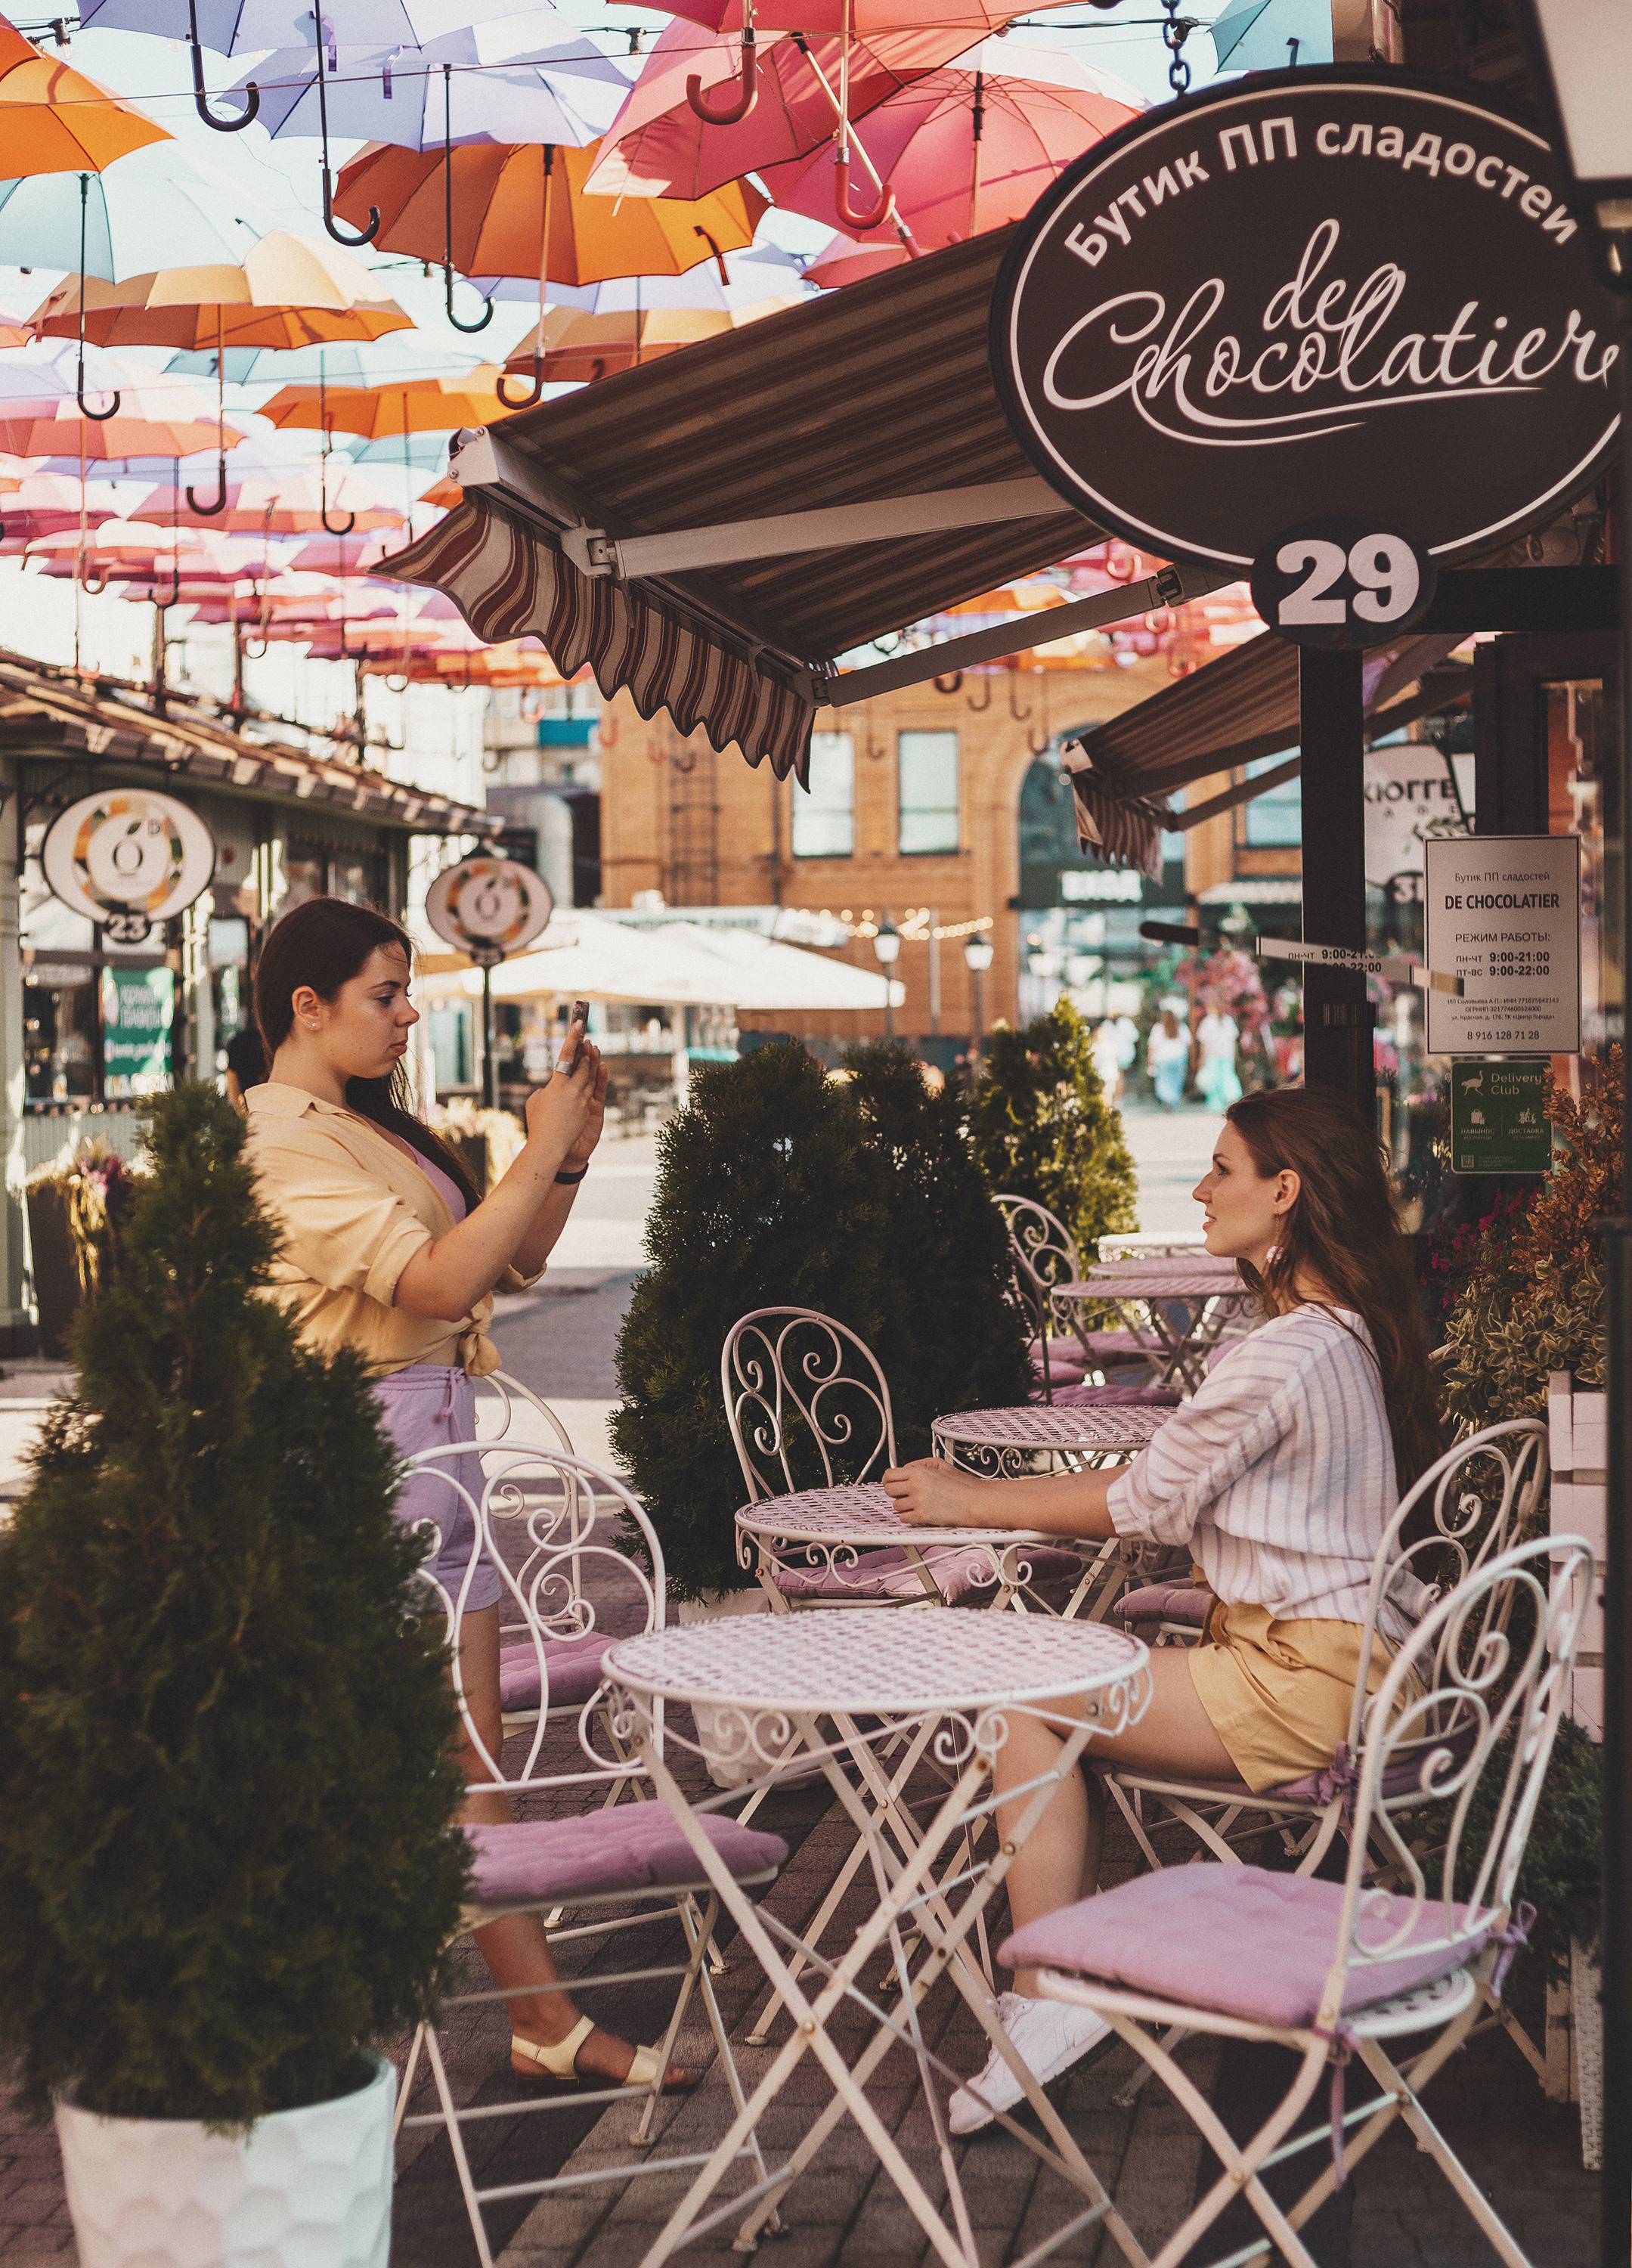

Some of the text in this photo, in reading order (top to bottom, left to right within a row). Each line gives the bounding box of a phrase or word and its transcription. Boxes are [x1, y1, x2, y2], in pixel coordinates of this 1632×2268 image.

[1064, 150, 1209, 266] Бутик
[1219, 116, 1298, 171] ПП
[1042, 262, 1620, 446] Chocolatier
[1277, 533, 1420, 626] 29
[1454, 871, 1550, 884] Бутик ПП сладостей
[1445, 893, 1560, 909] DE CHOCOLATIER
[108, 913, 148, 940] 23
[1455, 931, 1550, 943] РЕЖИМ РАБОТЫ:
[1489, 951, 1550, 962] 9:00-21:00
[1489, 965, 1550, 976] 9:00-22:00
[1466, 1030, 1540, 1040] 8 916 128 71 28
[1491, 1073, 1542, 1085] Delivery
[1491, 1085, 1520, 1095] Club
